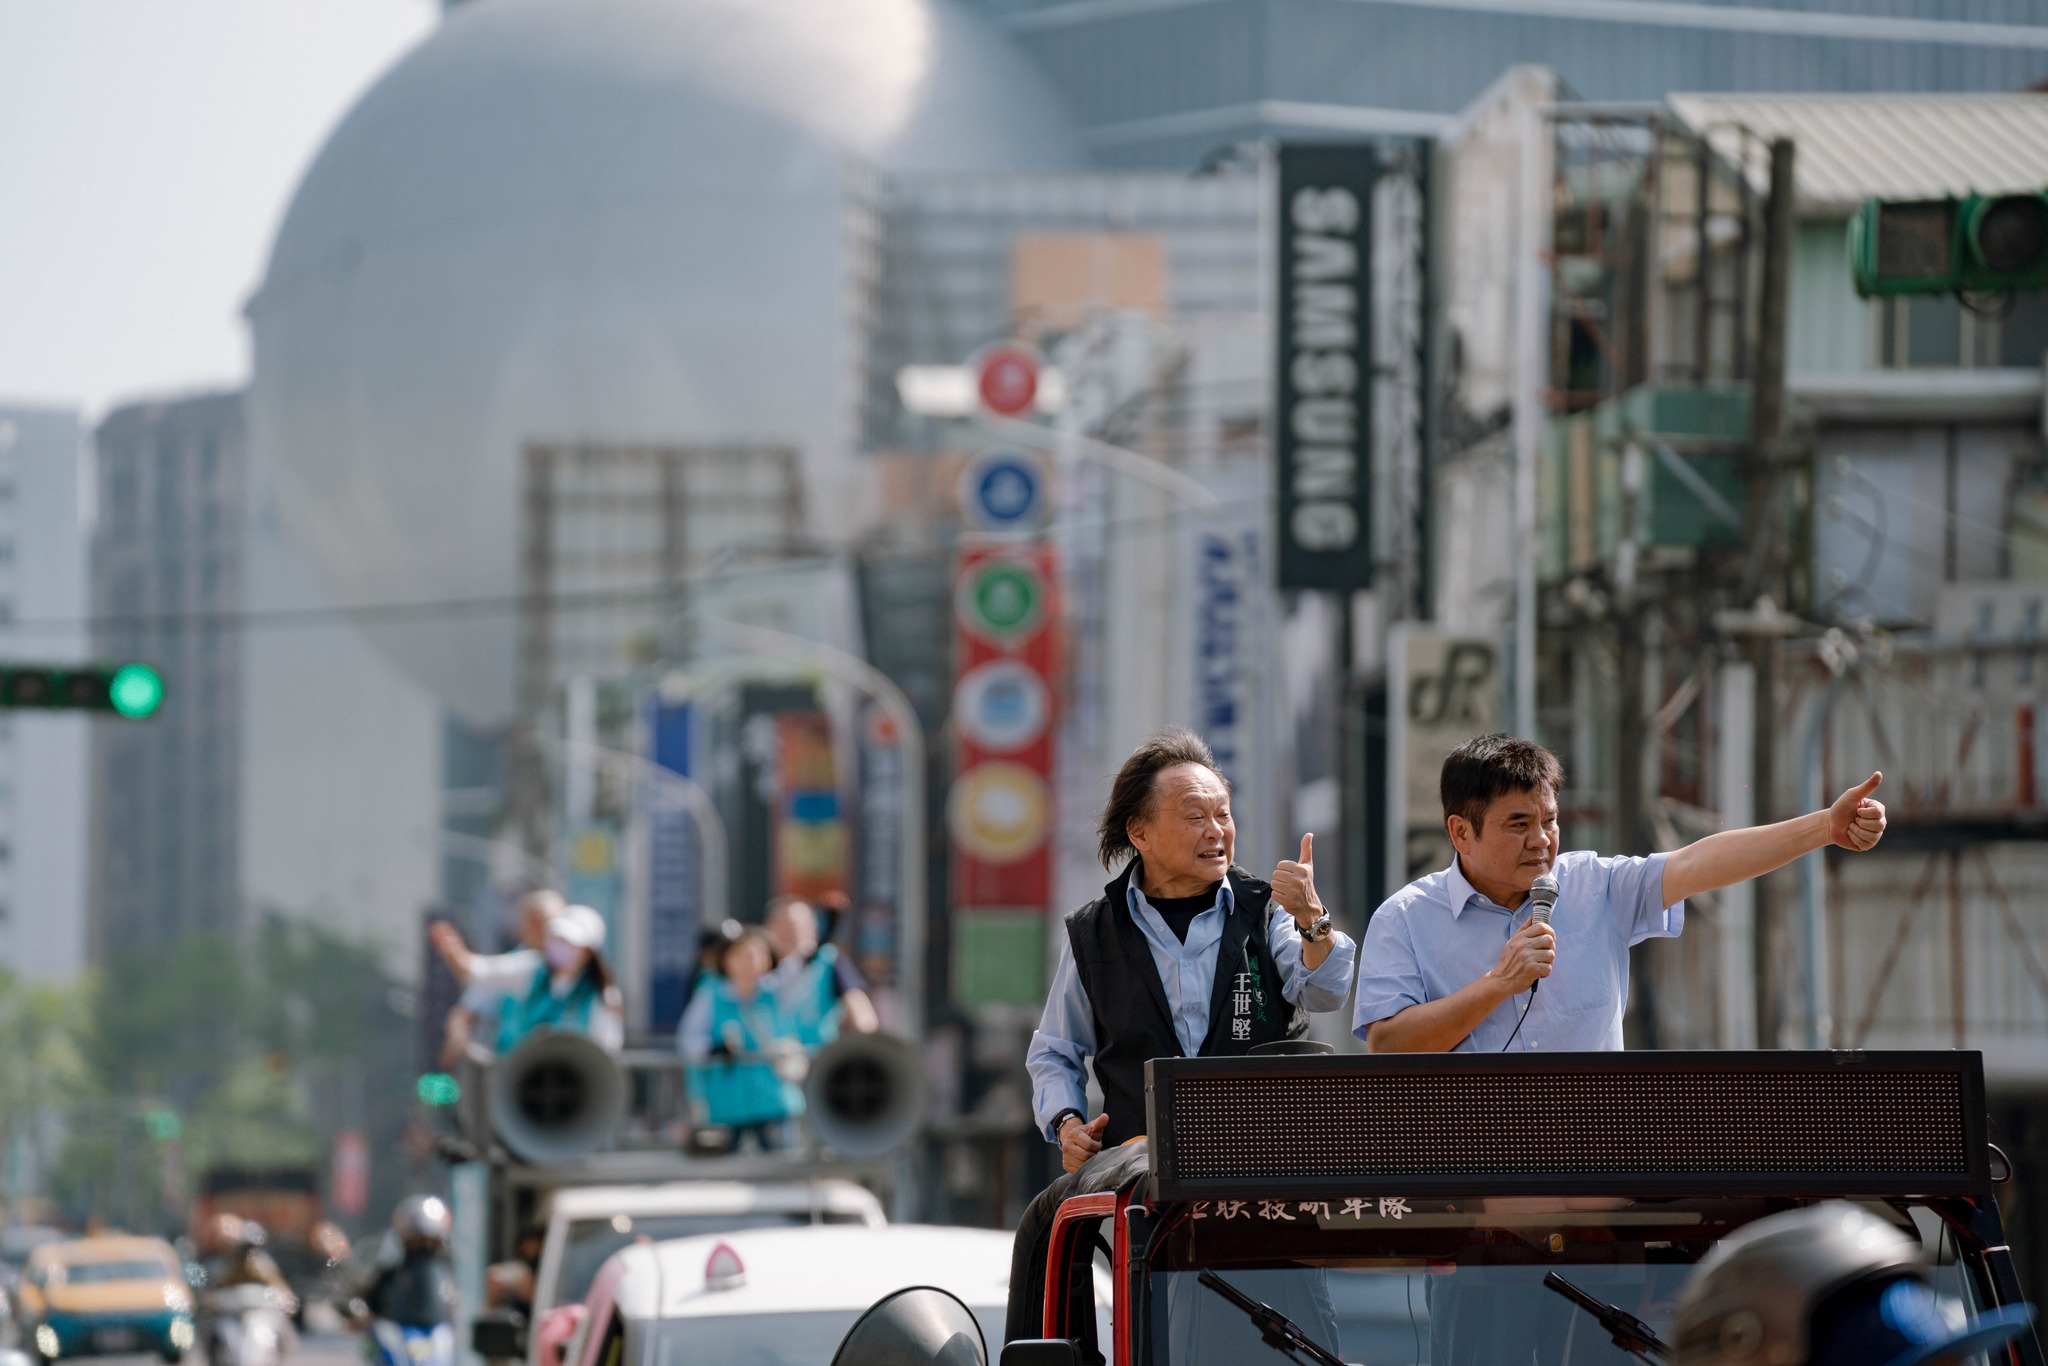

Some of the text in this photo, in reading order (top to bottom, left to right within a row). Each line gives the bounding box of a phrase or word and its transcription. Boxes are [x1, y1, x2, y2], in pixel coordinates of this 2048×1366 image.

[1291, 186, 1358, 552] SAMSUNG
[1231, 973, 1252, 1040] 王世堅
